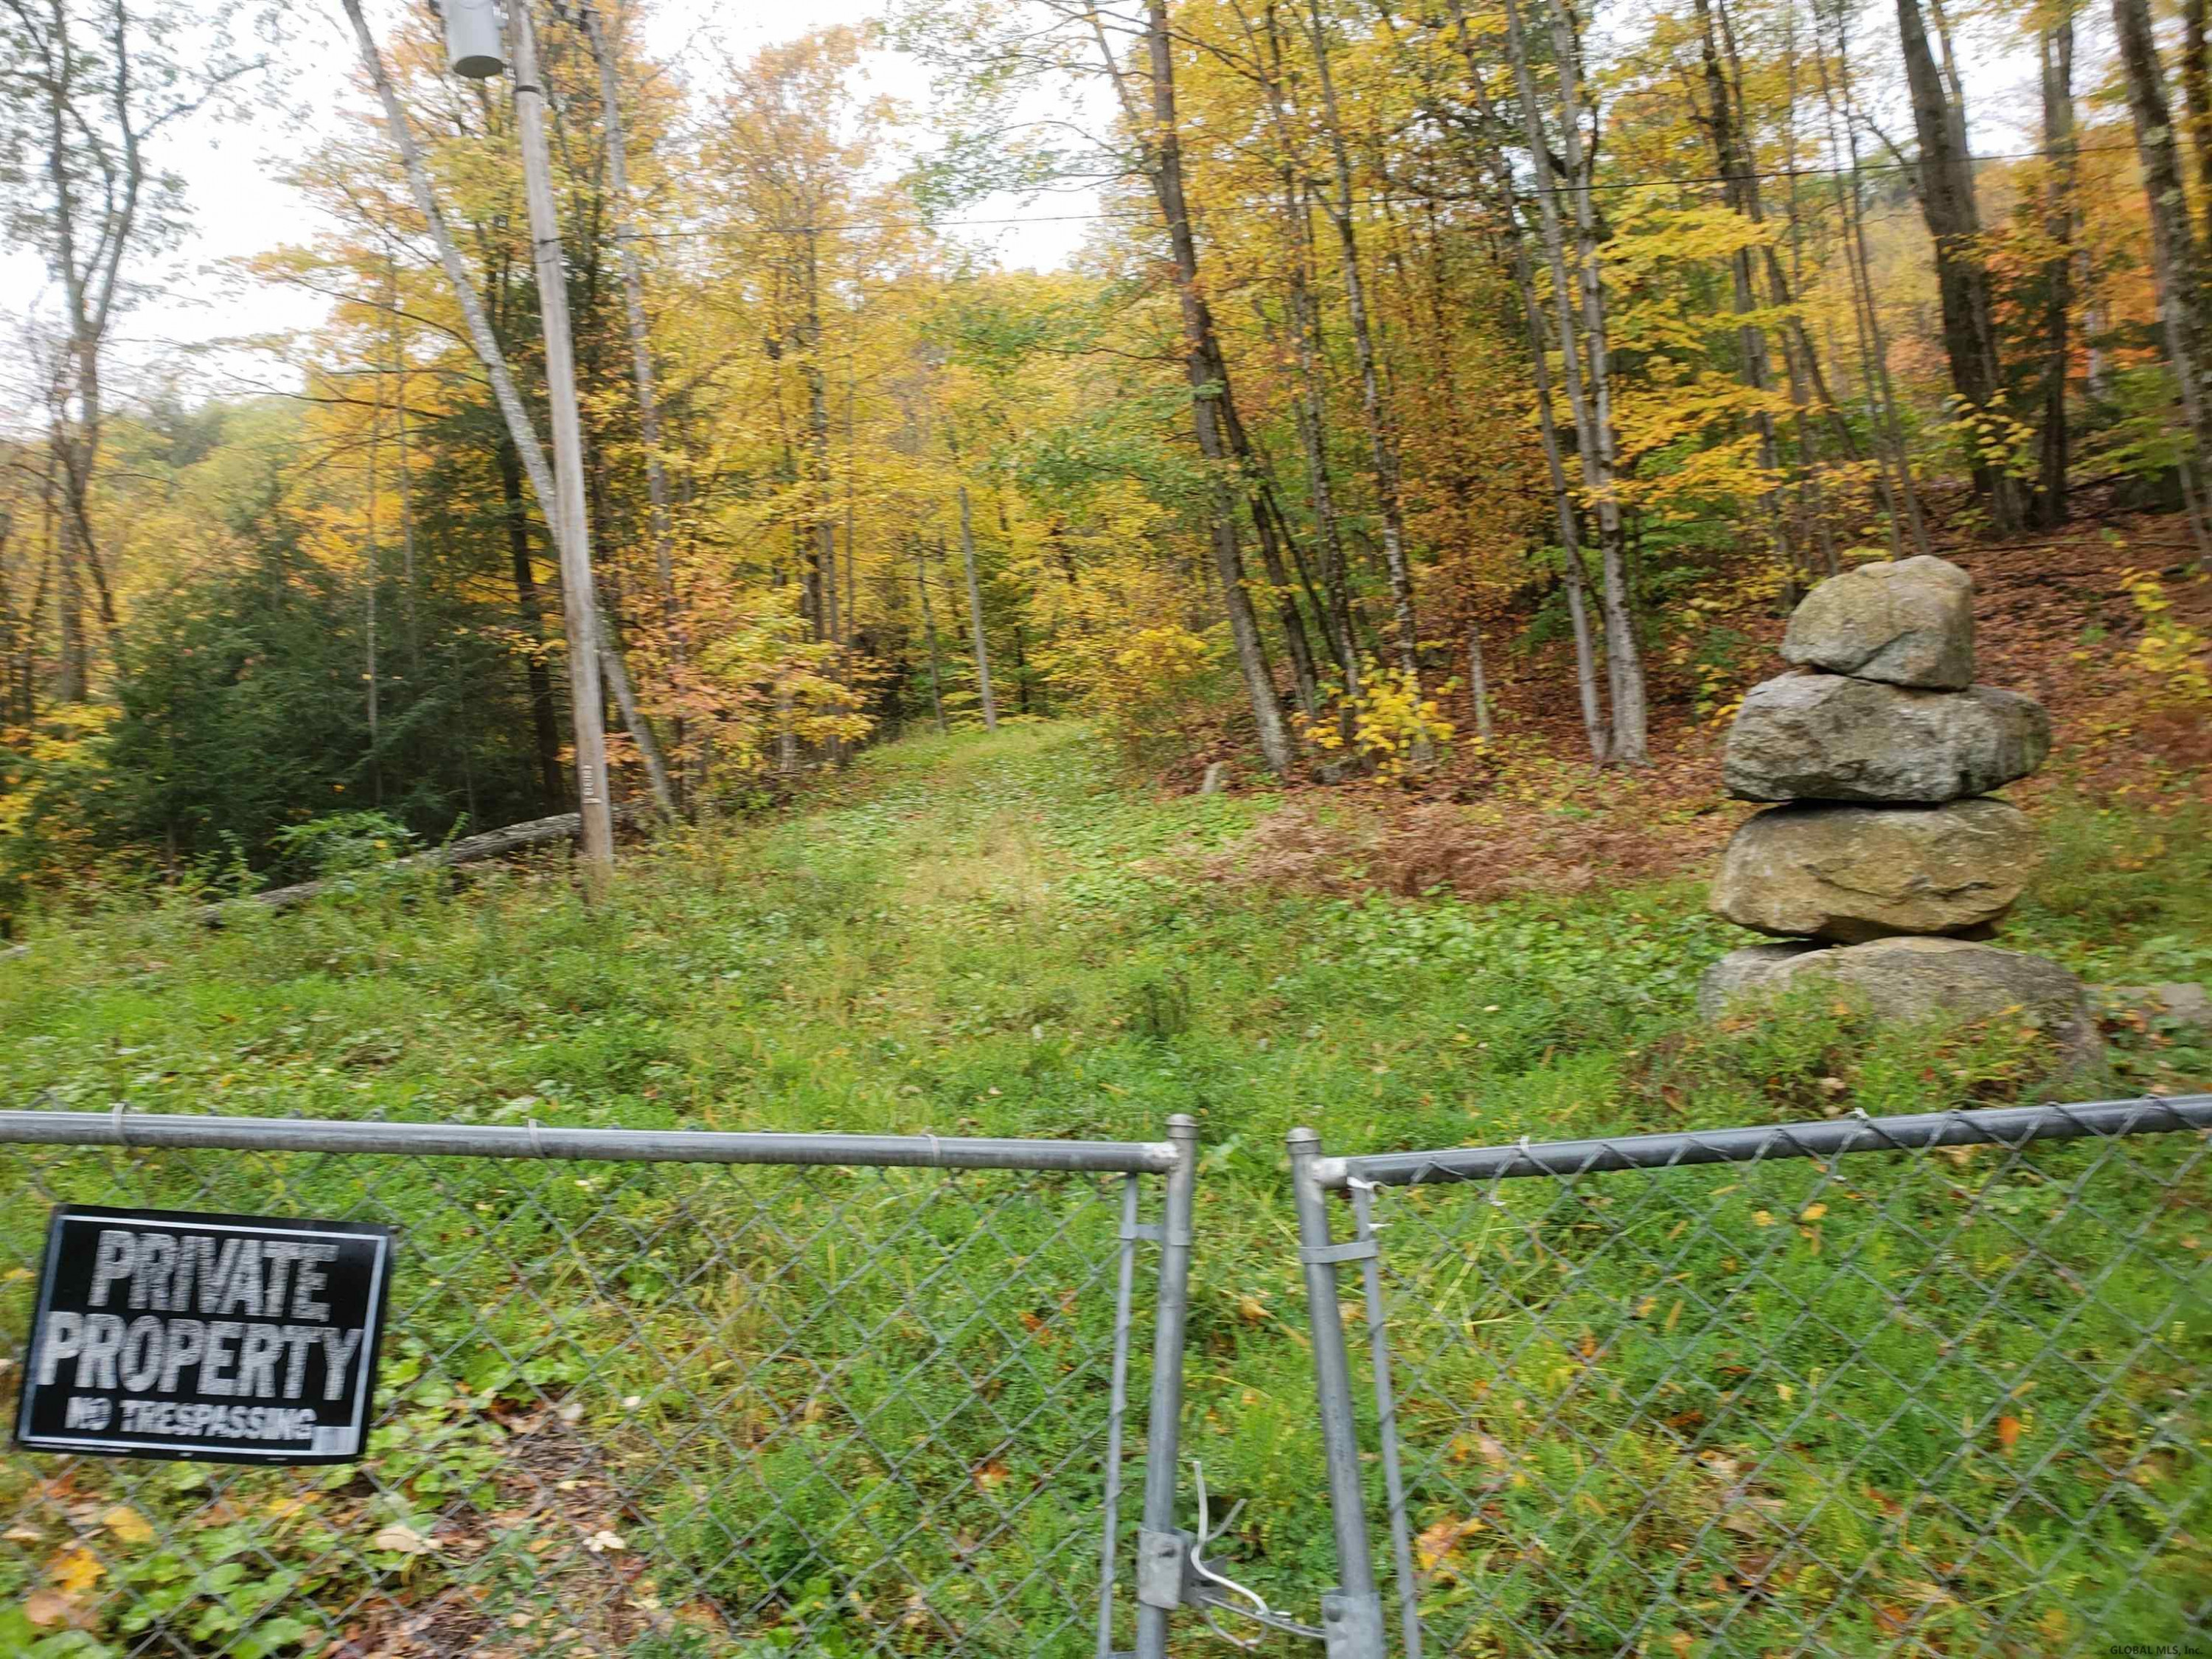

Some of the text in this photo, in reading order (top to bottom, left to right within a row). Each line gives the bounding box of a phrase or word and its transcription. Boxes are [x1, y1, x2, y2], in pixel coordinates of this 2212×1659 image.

[88, 1230, 339, 1322] PRIVATE
[37, 1311, 364, 1400] PROPERTY
[65, 1397, 318, 1440] NO TRESPASSING
